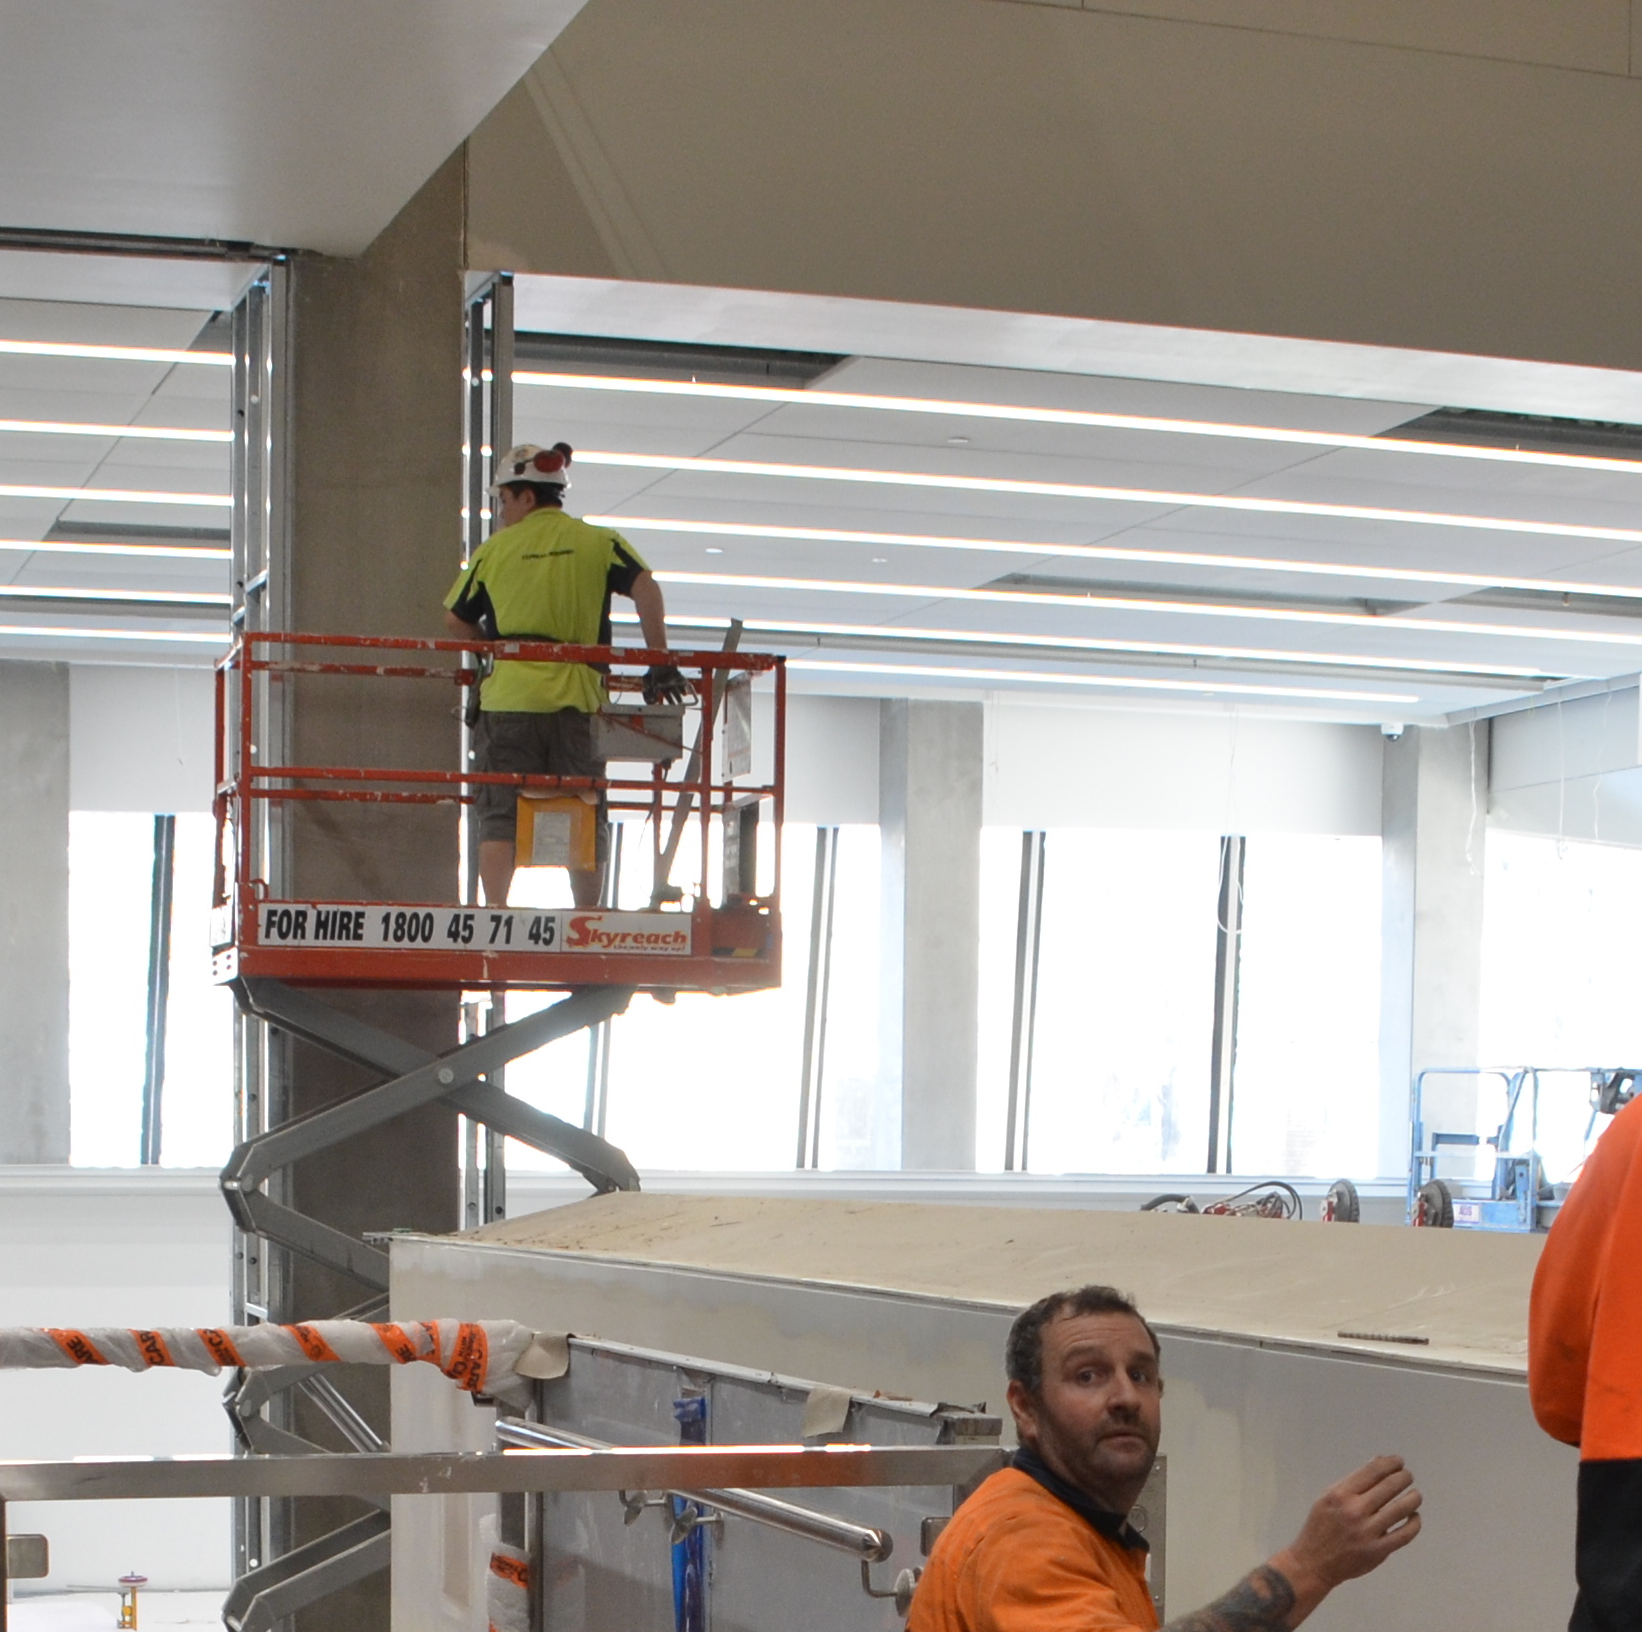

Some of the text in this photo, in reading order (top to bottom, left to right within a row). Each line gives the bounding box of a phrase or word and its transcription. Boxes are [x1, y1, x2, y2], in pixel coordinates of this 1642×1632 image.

[263, 909, 557, 947] FOR HIRE 1800 45 71 45
[566, 916, 687, 947] Skyreach
[66, 1335, 100, 1364] ARE
